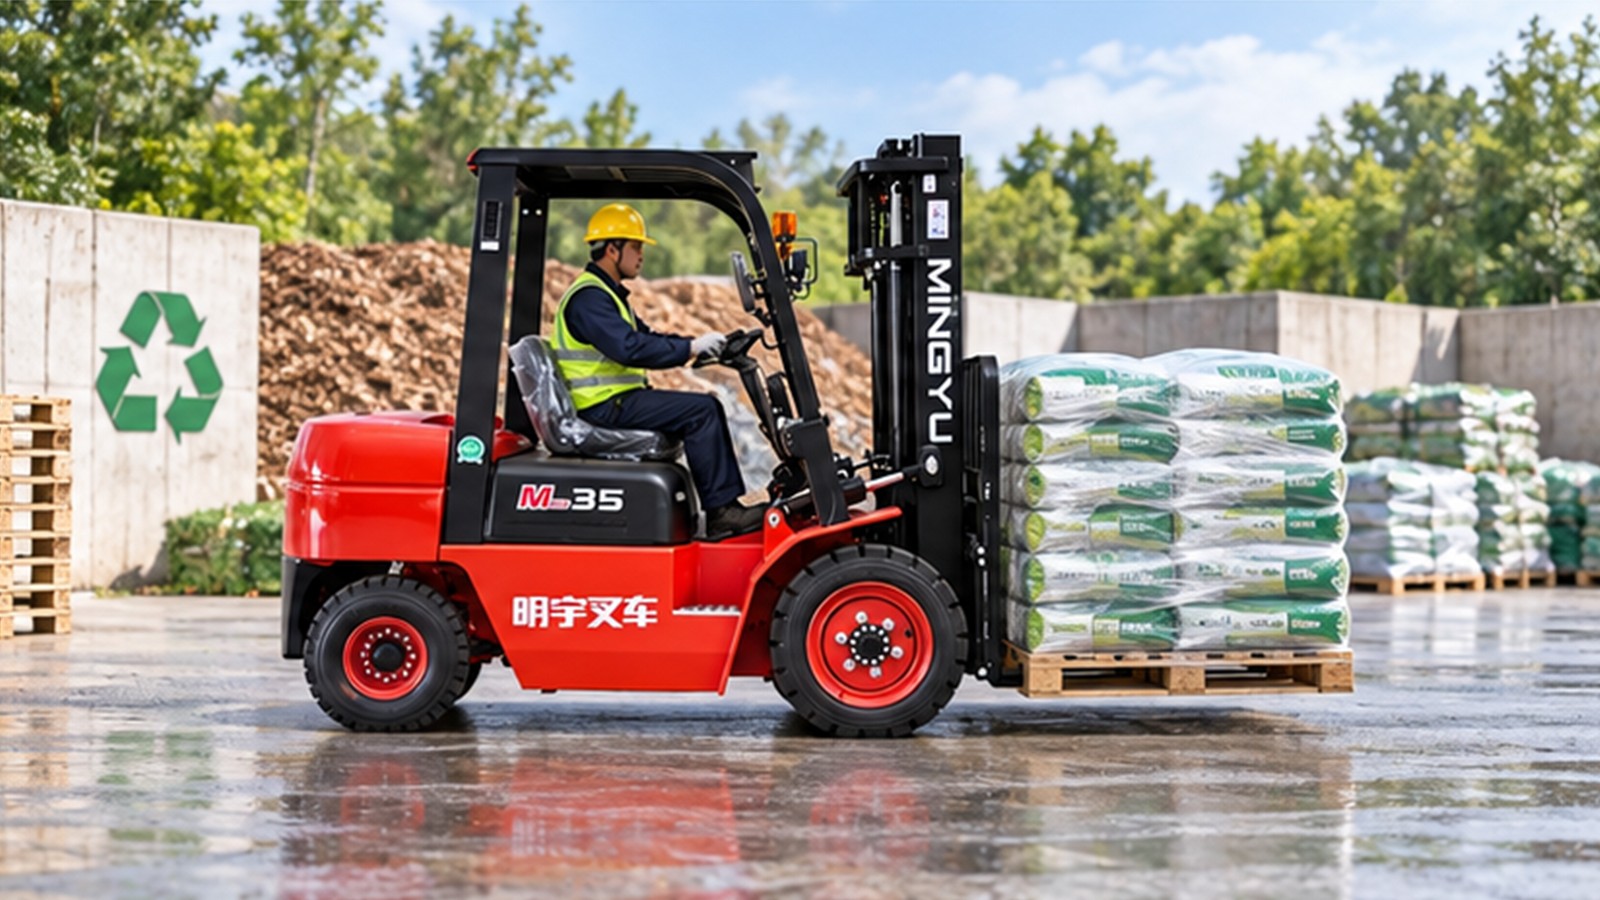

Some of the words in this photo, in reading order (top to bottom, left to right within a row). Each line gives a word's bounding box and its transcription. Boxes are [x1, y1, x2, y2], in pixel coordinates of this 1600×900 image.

[927, 258, 952, 443] MINGYU
[512, 595, 659, 629] 明宇叉车
